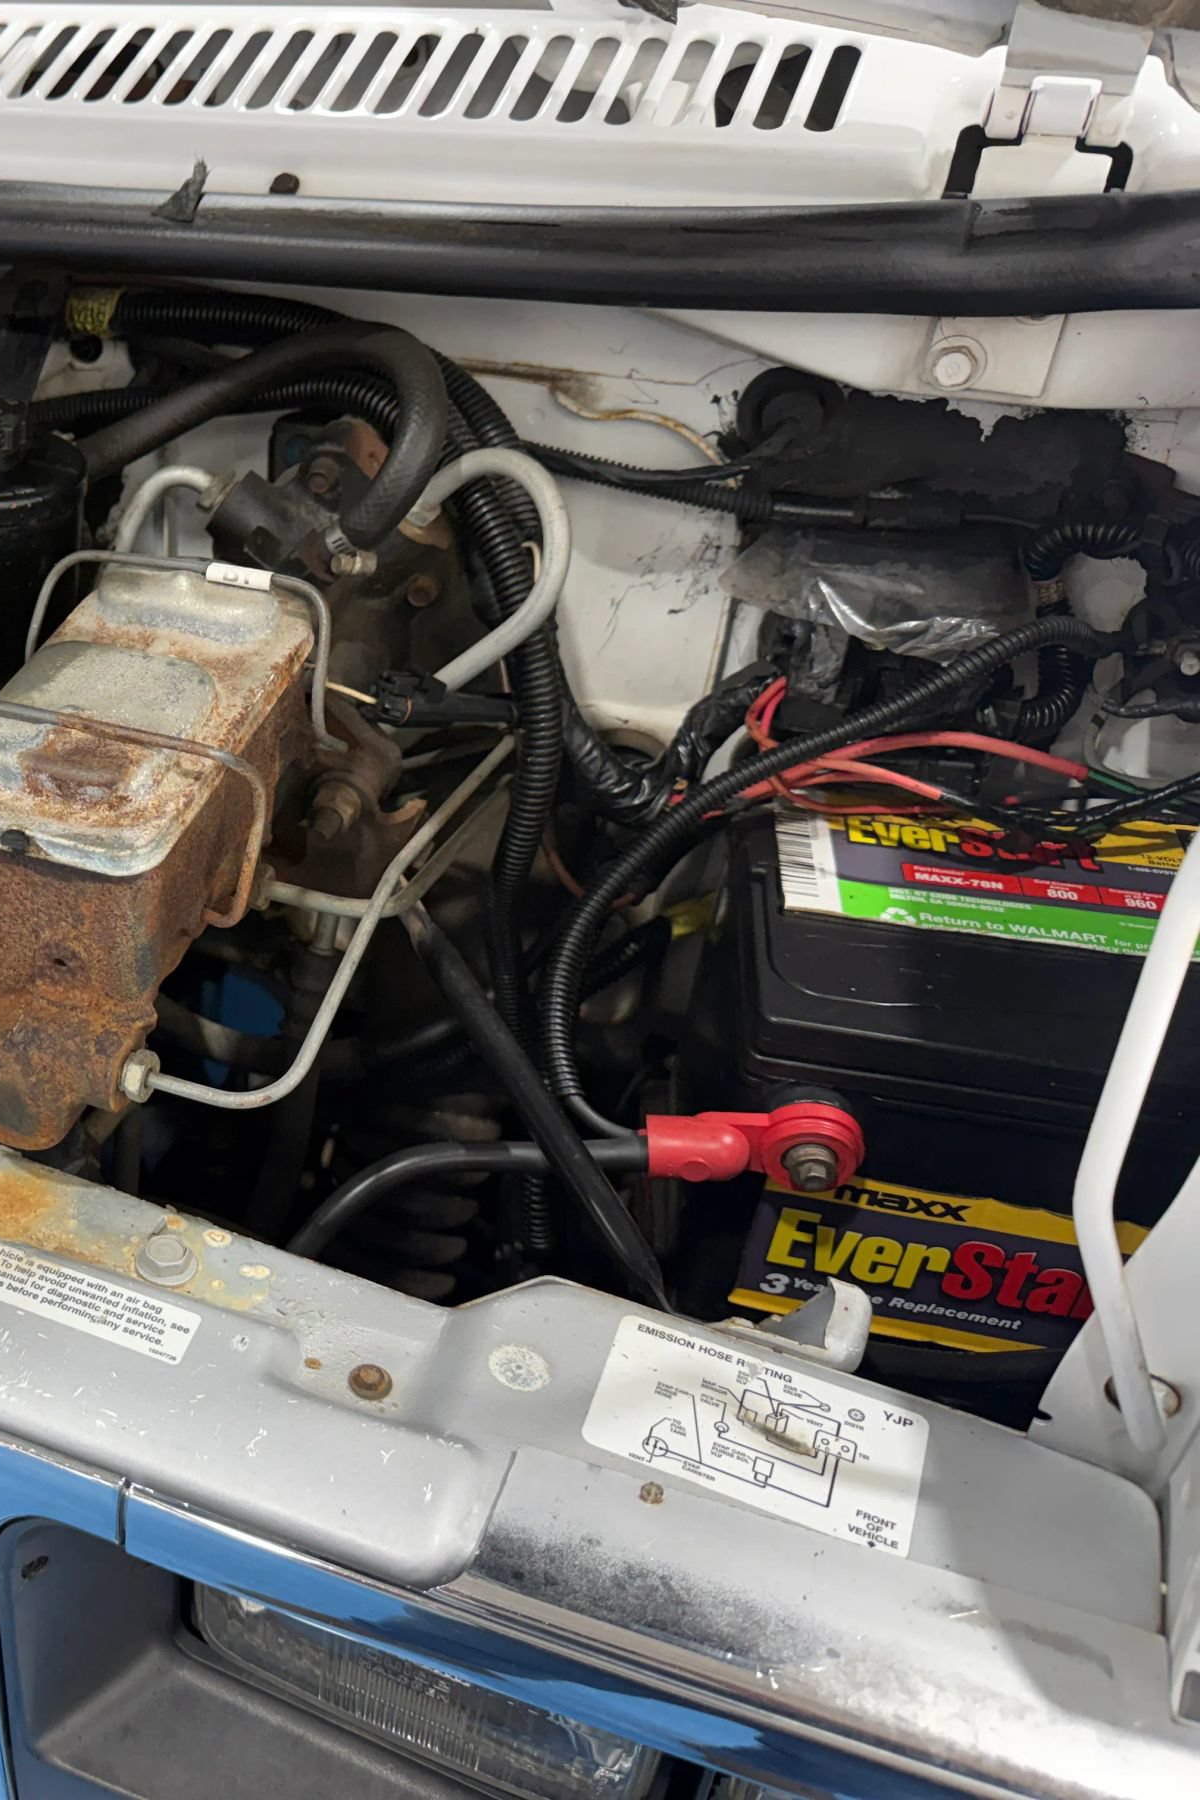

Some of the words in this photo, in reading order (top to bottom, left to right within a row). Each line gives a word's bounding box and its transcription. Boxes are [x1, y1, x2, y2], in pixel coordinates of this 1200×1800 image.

[1046, 889, 1078, 900] 800
[1125, 898, 1157, 910] 960
[919, 912, 981, 929] Return
[984, 920, 1005, 931] to
[1008, 923, 1108, 944] WALMART
[1113, 938, 1133, 948] for
[0, 1259, 13, 1270] To
[14, 1265, 36, 1279] help
[38, 1274, 67, 1289] avoid
[68, 1285, 121, 1309] unwanted
[121, 1302, 168, 1328] inflation,
[170, 1322, 191, 1335] see
[25, 1259, 35, 1267] is
[36, 1260, 88, 1285] equipped
[87, 1279, 109, 1295] with
[110, 1289, 124, 1300] an
[126, 1293, 141, 1305] air
[142, 1299, 163, 1315] bag
[759, 1272, 790, 1294] 3
[793, 1277, 826, 1293] Yea
[6, 1282, 40, 1301] before
[101, 1318, 121, 1332] any
[121, 1326, 164, 1347] service.
[30, 1280, 46, 1293] for
[47, 1287, 102, 1313] diagnostic
[103, 1308, 125, 1321] and
[125, 1316, 166, 1336] service
[888, 1296, 1023, 1331] Replacement
[637, 1323, 697, 1350] EMISSION
[698, 1344, 734, 1363] HOSE
[736, 1357, 793, 1384] RTING
[883, 1410, 915, 1428] YJP
[855, 1508, 897, 1530] FRONT
[866, 1522, 884, 1533] OF
[848, 1523, 899, 1550] VEHICLE
